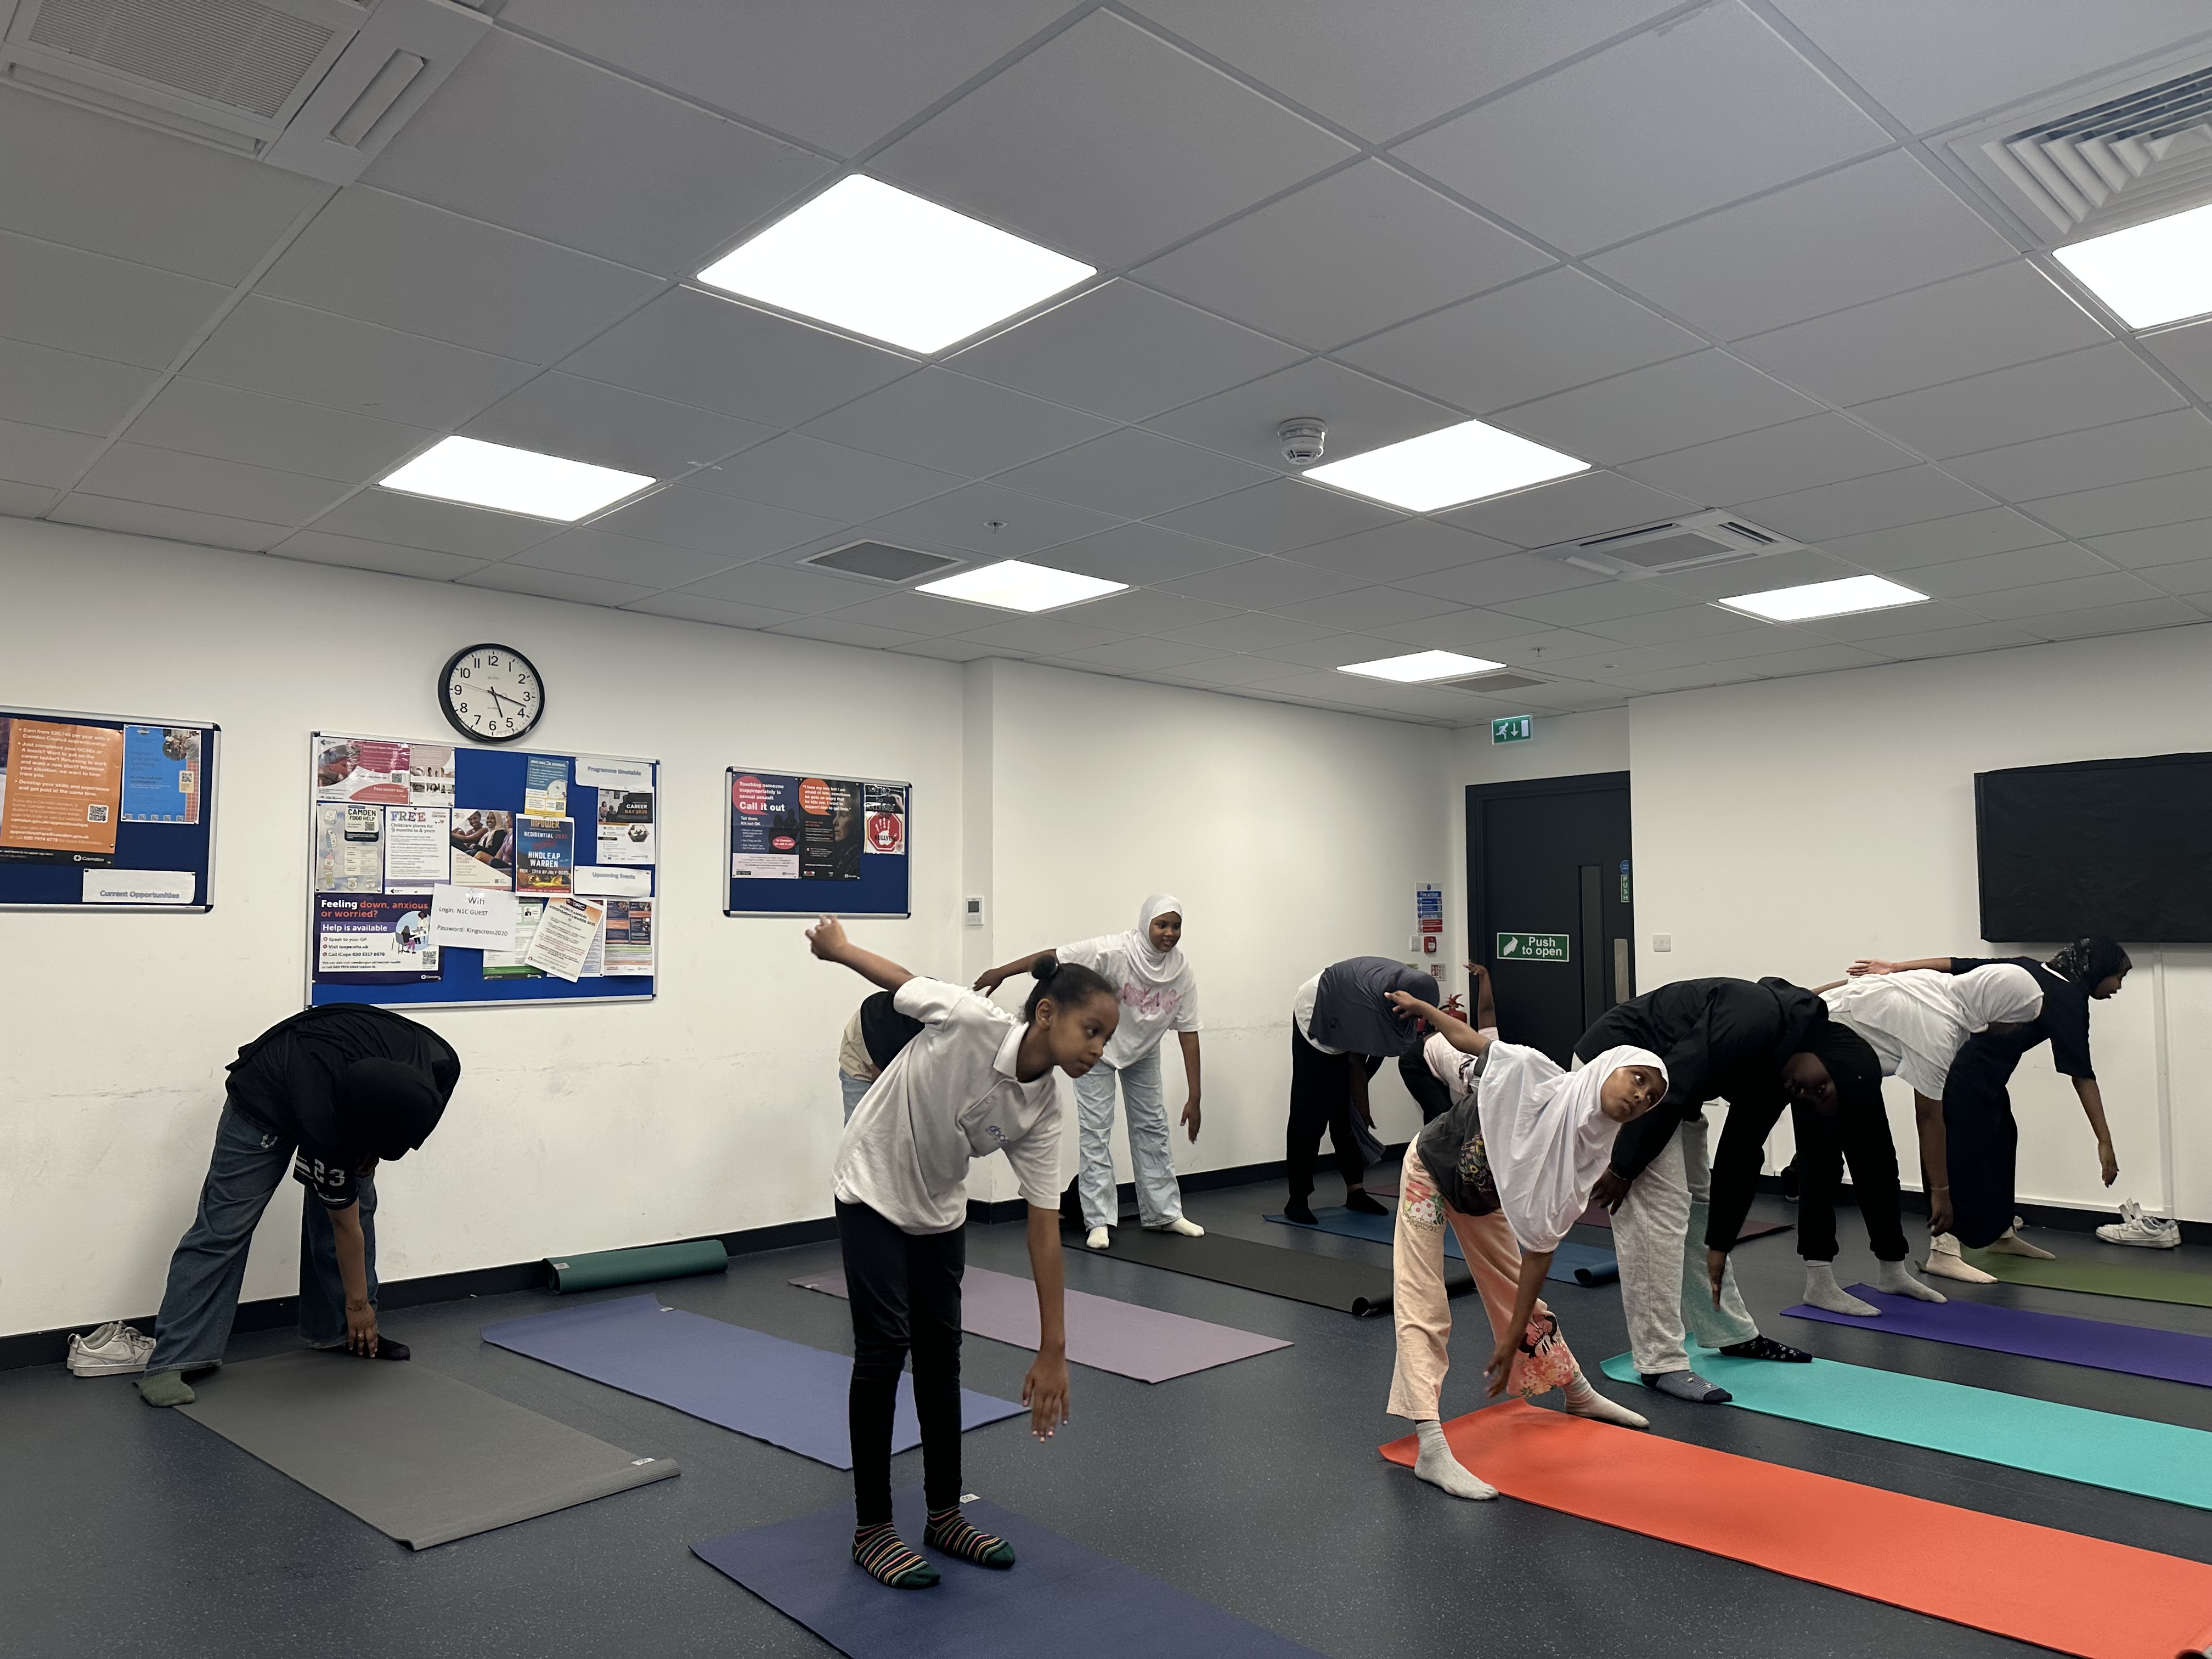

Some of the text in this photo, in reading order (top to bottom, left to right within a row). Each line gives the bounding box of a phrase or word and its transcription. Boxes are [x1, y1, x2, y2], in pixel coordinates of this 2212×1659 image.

[474, 658, 480, 669] 11
[488, 655, 499, 666] 12
[509, 662, 511, 672] 1
[460, 667, 471, 679] 10
[518, 674, 526, 684] 2
[454, 685, 462, 695] 9
[523, 691, 531, 702] 3
[460, 702, 468, 713] 8
[517, 708, 525, 718] 4
[473, 714, 481, 725] 7
[506, 718, 514, 728] 5
[489, 720, 496, 731] 6
[588, 766, 617, 774] Programme
[868, 786, 878, 794] Say
[740, 802, 757, 810] Call
[391, 811, 426, 822] FREE
[530, 859, 558, 867] WARREN
[321, 900, 358, 910] Feeling
[360, 901, 390, 909] down,
[468, 897, 485, 905] Wifi
[323, 924, 342, 932] Help
[466, 928, 508, 936] Kingscross2020
[1528, 936, 1555, 947] Push
[1522, 946, 1562, 957] to open
[314, 1159, 345, 1186] 23
